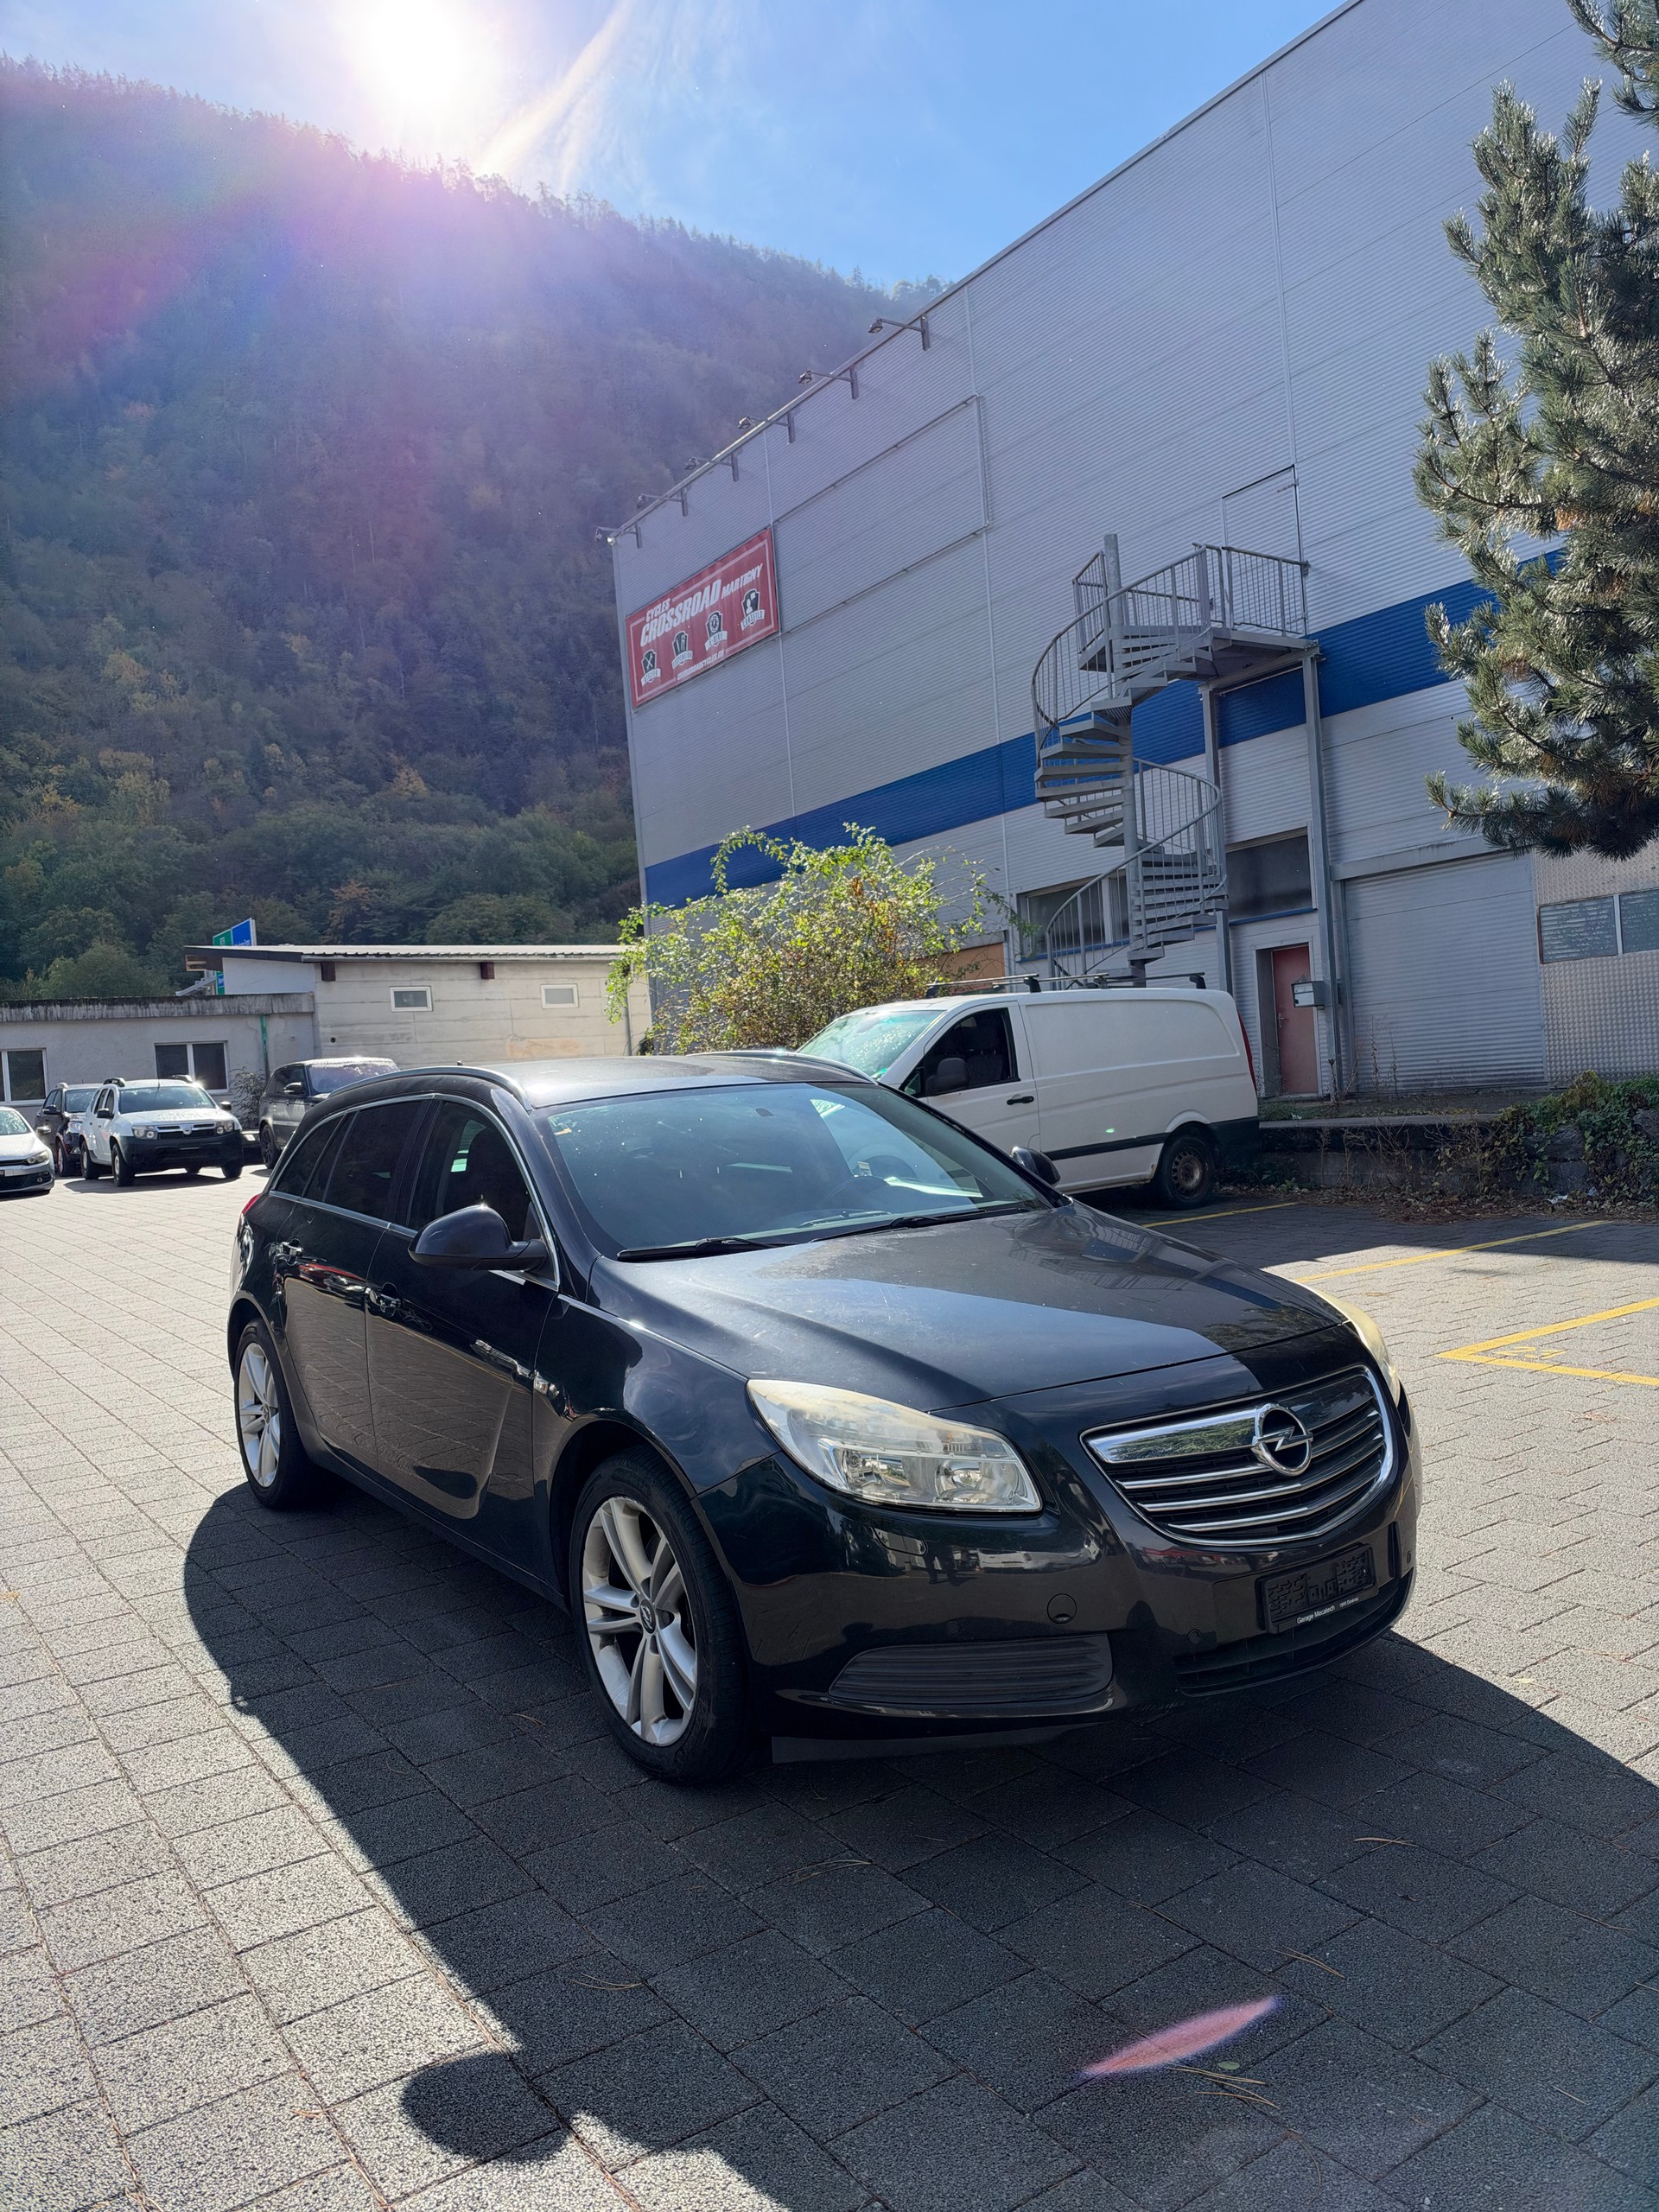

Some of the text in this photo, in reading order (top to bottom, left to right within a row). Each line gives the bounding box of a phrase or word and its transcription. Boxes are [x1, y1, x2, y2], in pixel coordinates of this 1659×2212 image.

[640, 563, 763, 647] CROSSROAD MARTIGNY
[645, 597, 671, 623] CYCLES
[1296, 1613, 1314, 1624] Garage
